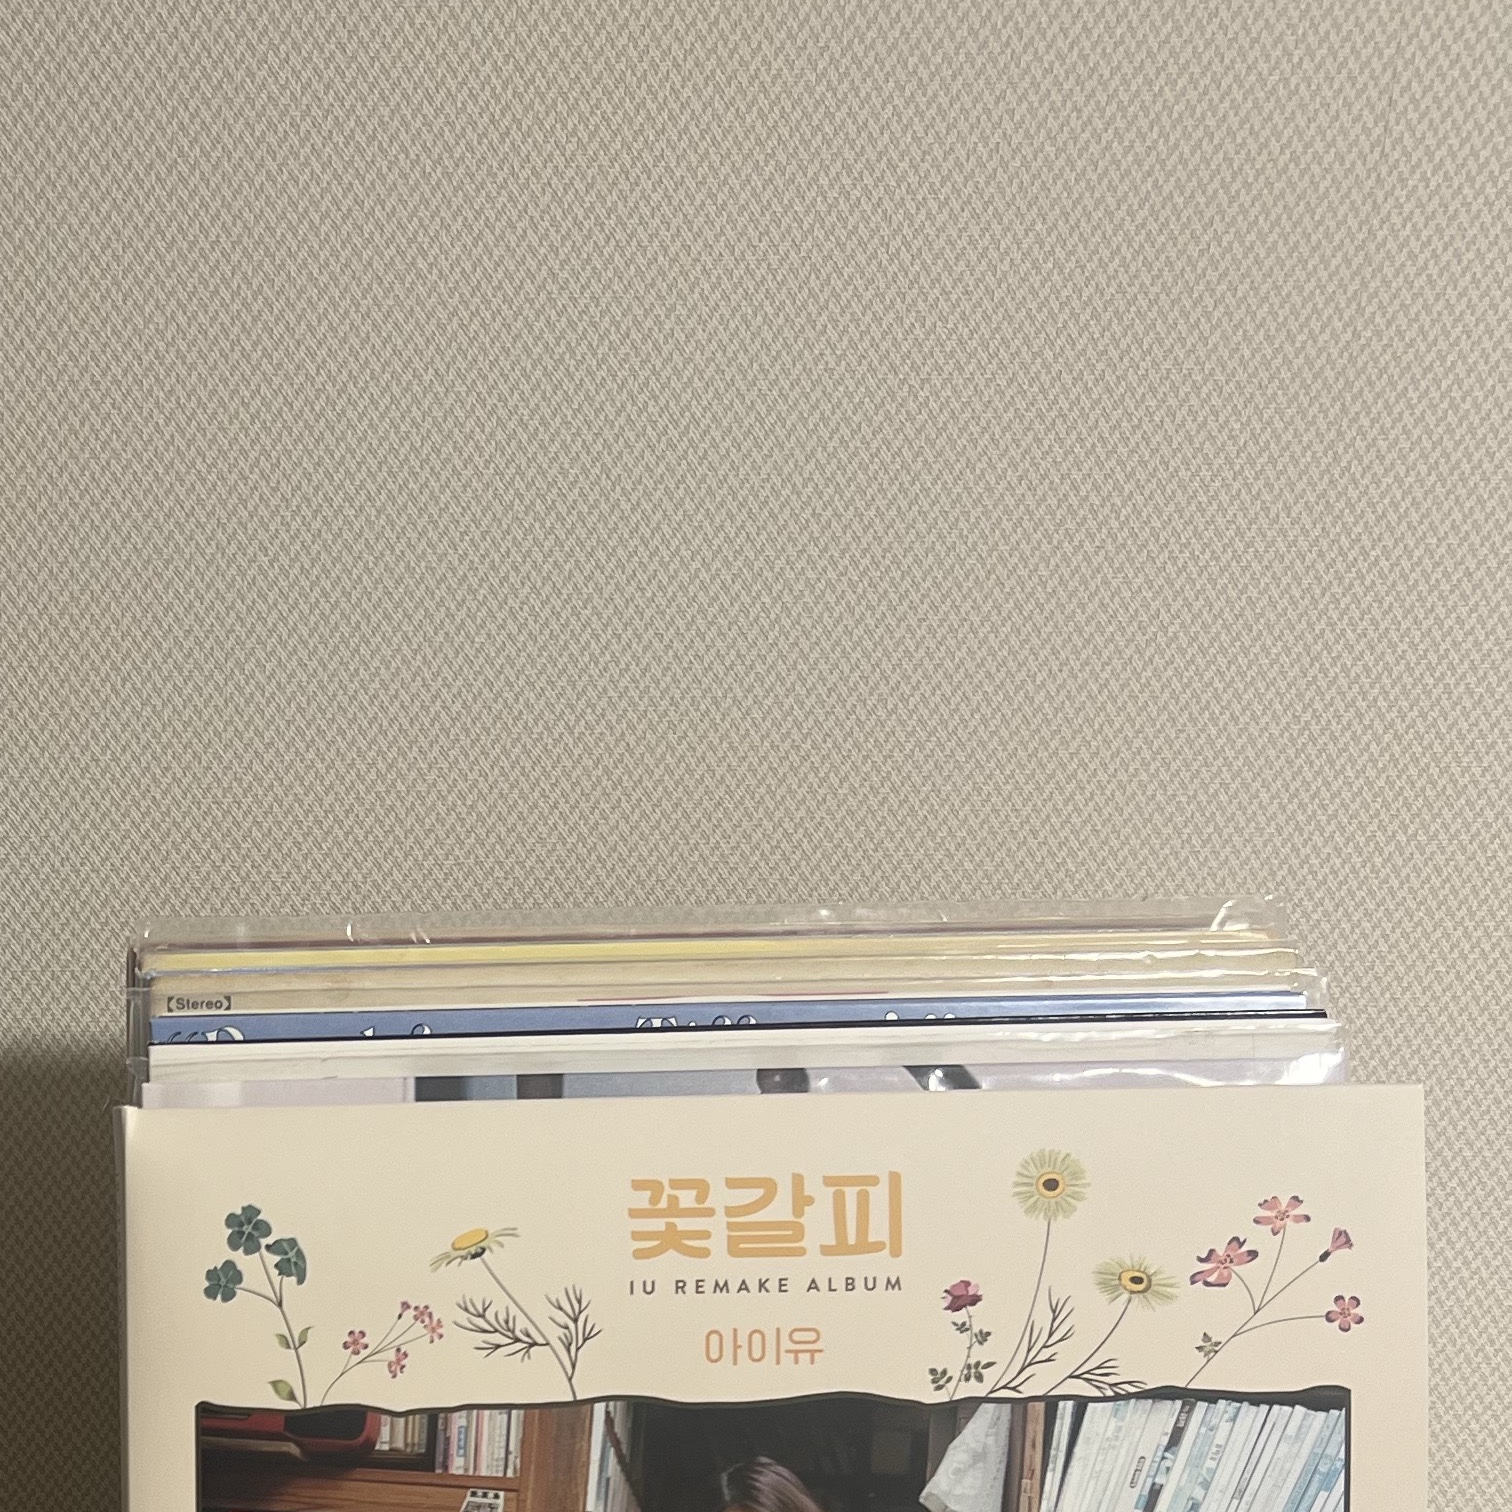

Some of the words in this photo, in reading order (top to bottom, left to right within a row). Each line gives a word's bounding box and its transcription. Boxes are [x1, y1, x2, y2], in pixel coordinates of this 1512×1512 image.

[627, 1170, 903, 1260] 꽃갈피
[628, 1280, 657, 1295] IU
[674, 1277, 790, 1295] REMAKE
[806, 1275, 903, 1293] ALBUM
[704, 1327, 825, 1366] 아이유
